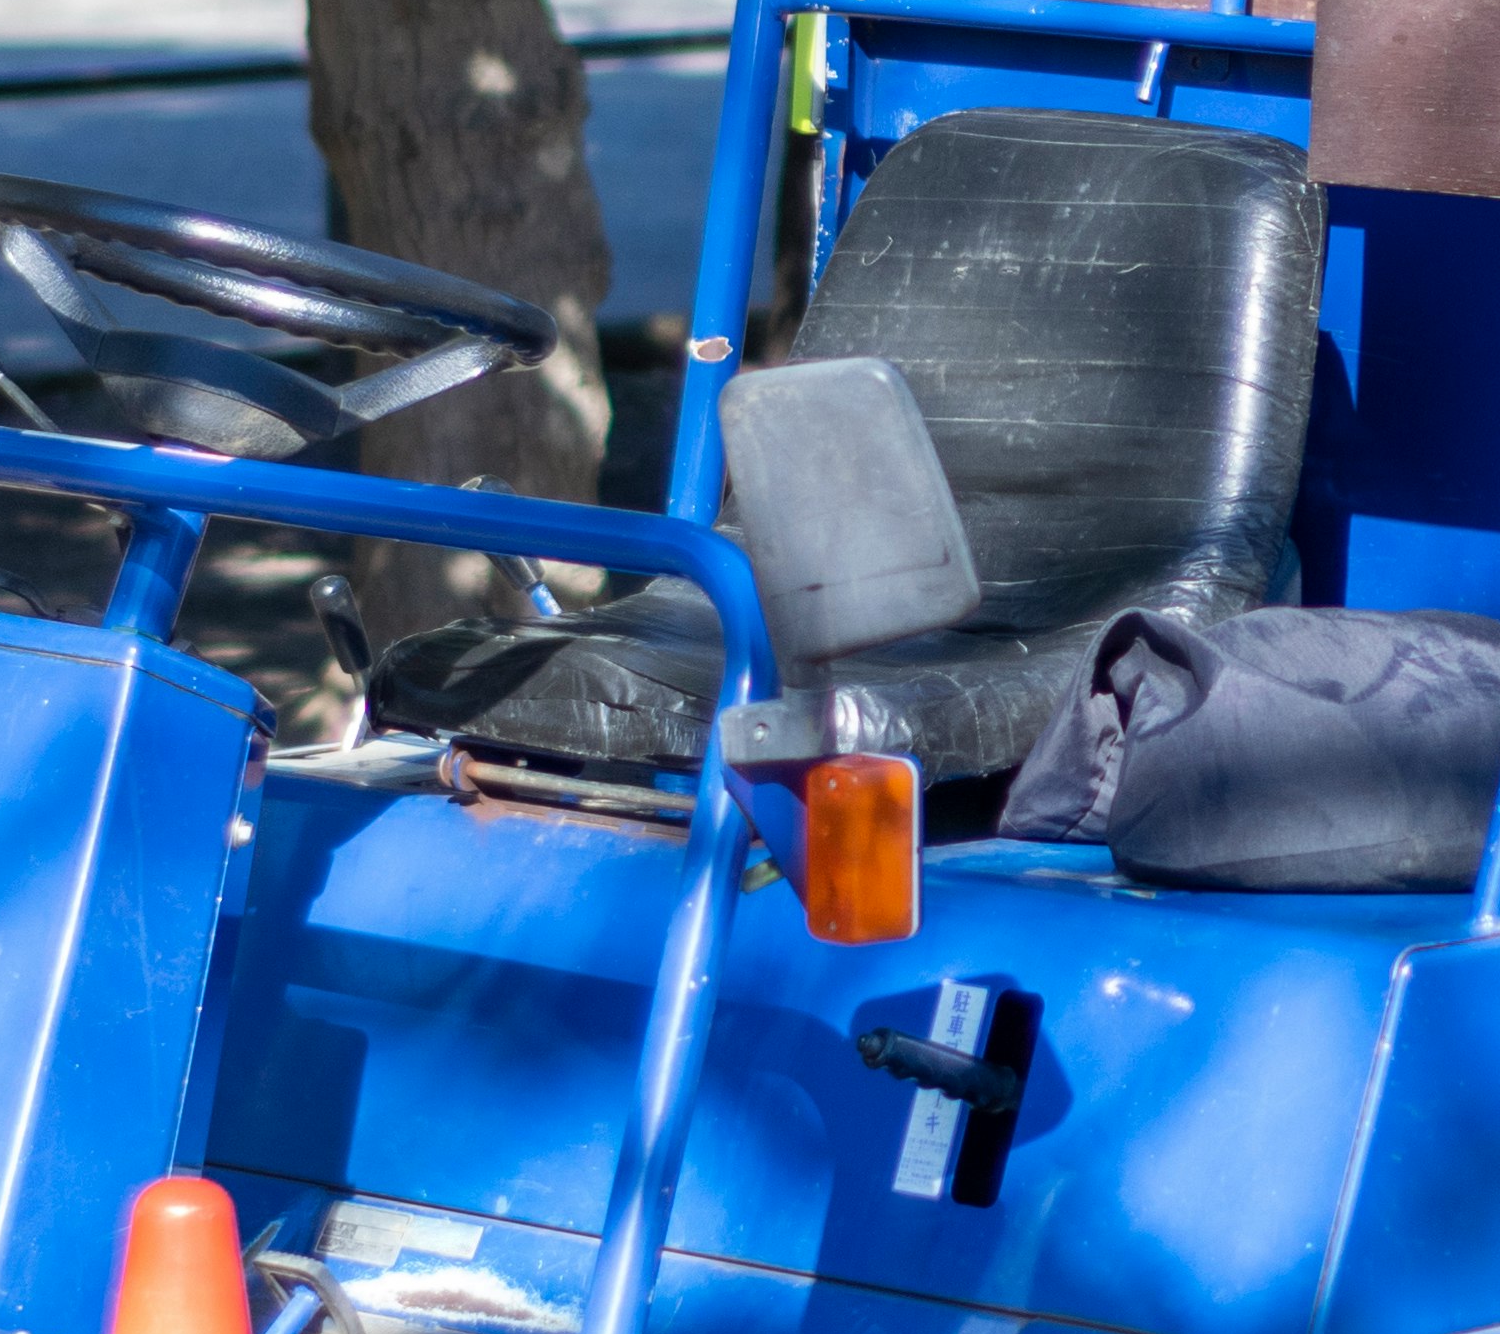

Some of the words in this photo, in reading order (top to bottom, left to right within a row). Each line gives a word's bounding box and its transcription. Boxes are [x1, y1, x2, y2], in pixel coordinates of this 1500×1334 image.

[925, 990, 971, 1134] 駐車ブーキ
